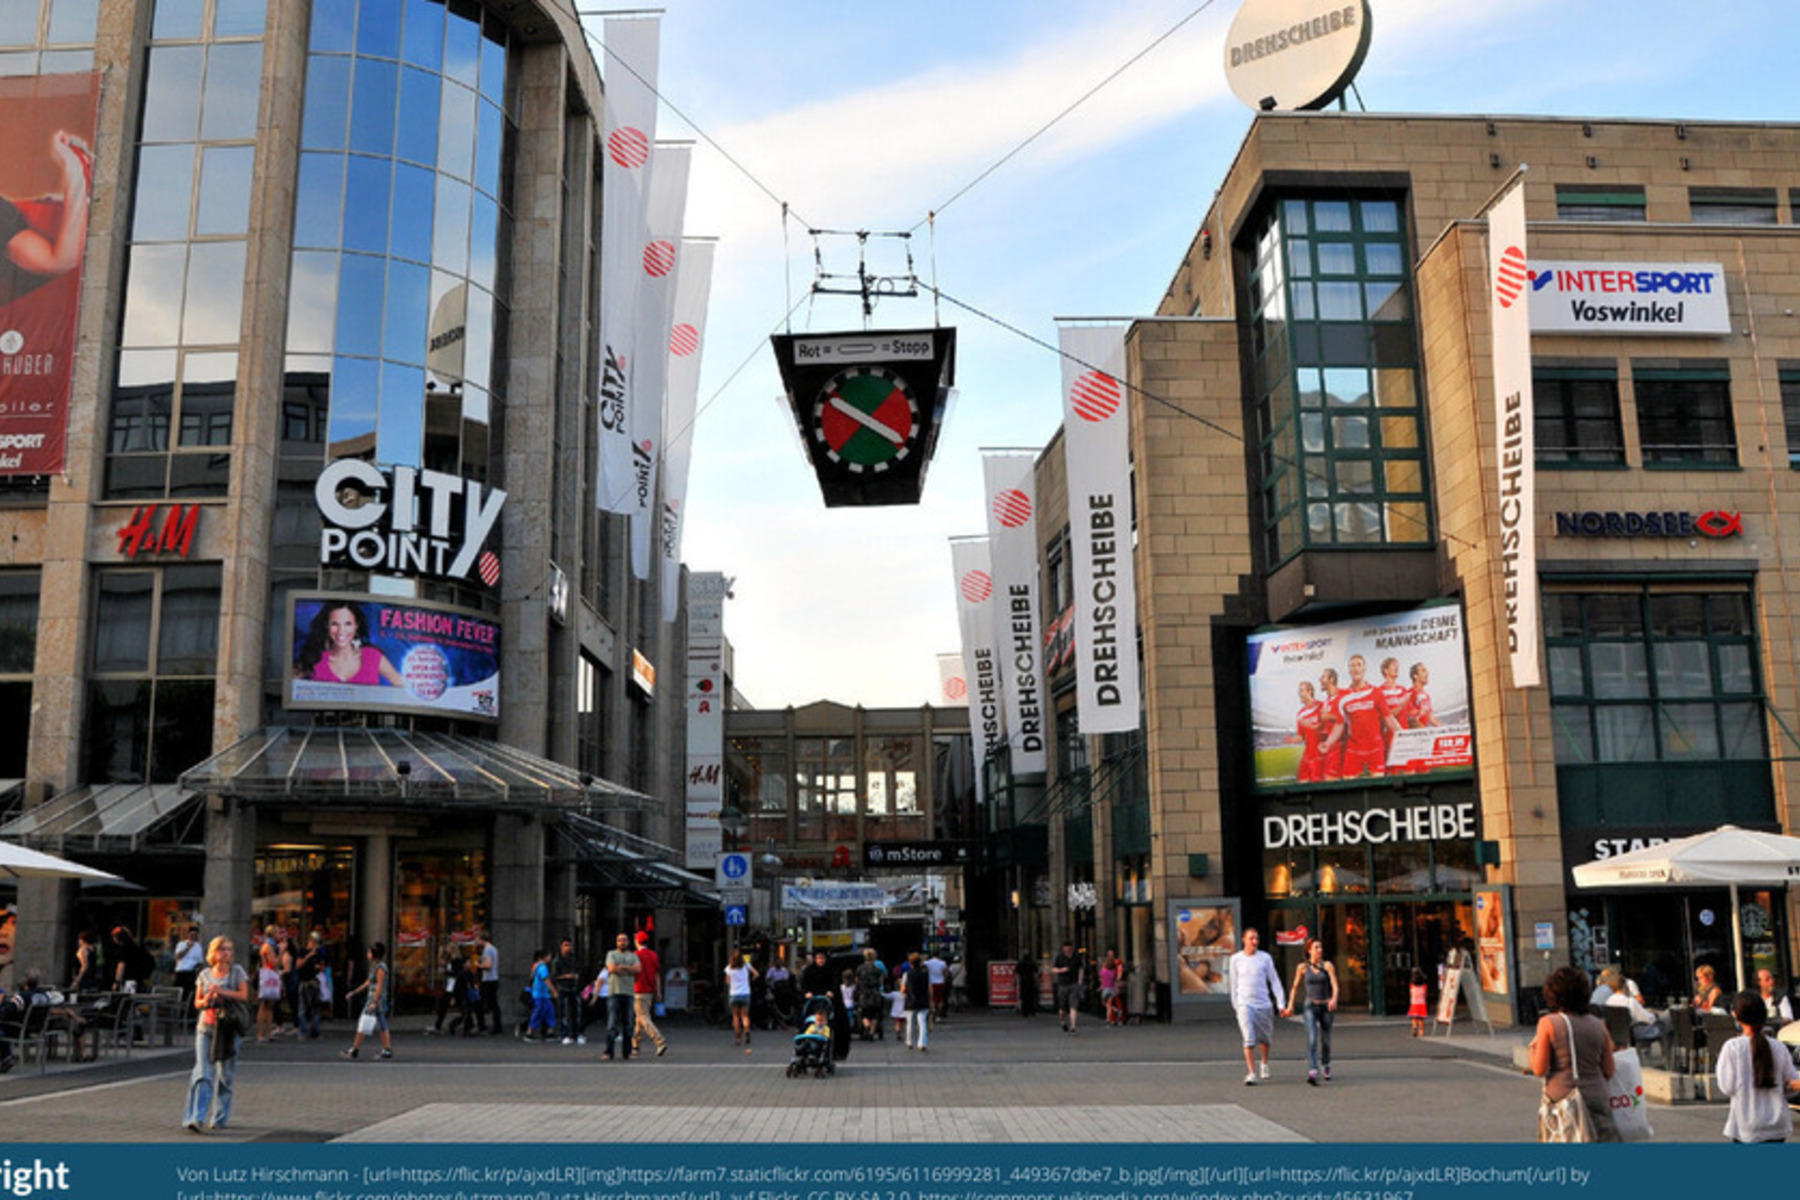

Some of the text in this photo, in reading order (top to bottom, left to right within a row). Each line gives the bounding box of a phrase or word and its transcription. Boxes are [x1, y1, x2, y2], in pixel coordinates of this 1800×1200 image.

[1230, 6, 1356, 67] DREHSCHEIBE
[1557, 270, 1714, 294] INTERSPORT
[1571, 299, 1684, 323] Voswinkel
[799, 343, 821, 358] Rot
[892, 340, 929, 356] Stopp
[601, 344, 625, 430] CITY
[116, 502, 199, 558] H&M
[315, 457, 508, 579] CITY
[1555, 511, 1692, 535] NORDSEE
[321, 527, 450, 576] POINT
[1089, 494, 1122, 707] DREHSCHEIBE
[381, 608, 453, 635] FASHION
[456, 618, 494, 644] FEVER
[1375, 628, 1459, 649] MANNSCHAFT
[1009, 584, 1043, 753] DREHSCHEIBE
[1263, 803, 1476, 848] DREHSCHEIBE
[886, 847, 942, 861] mStore
